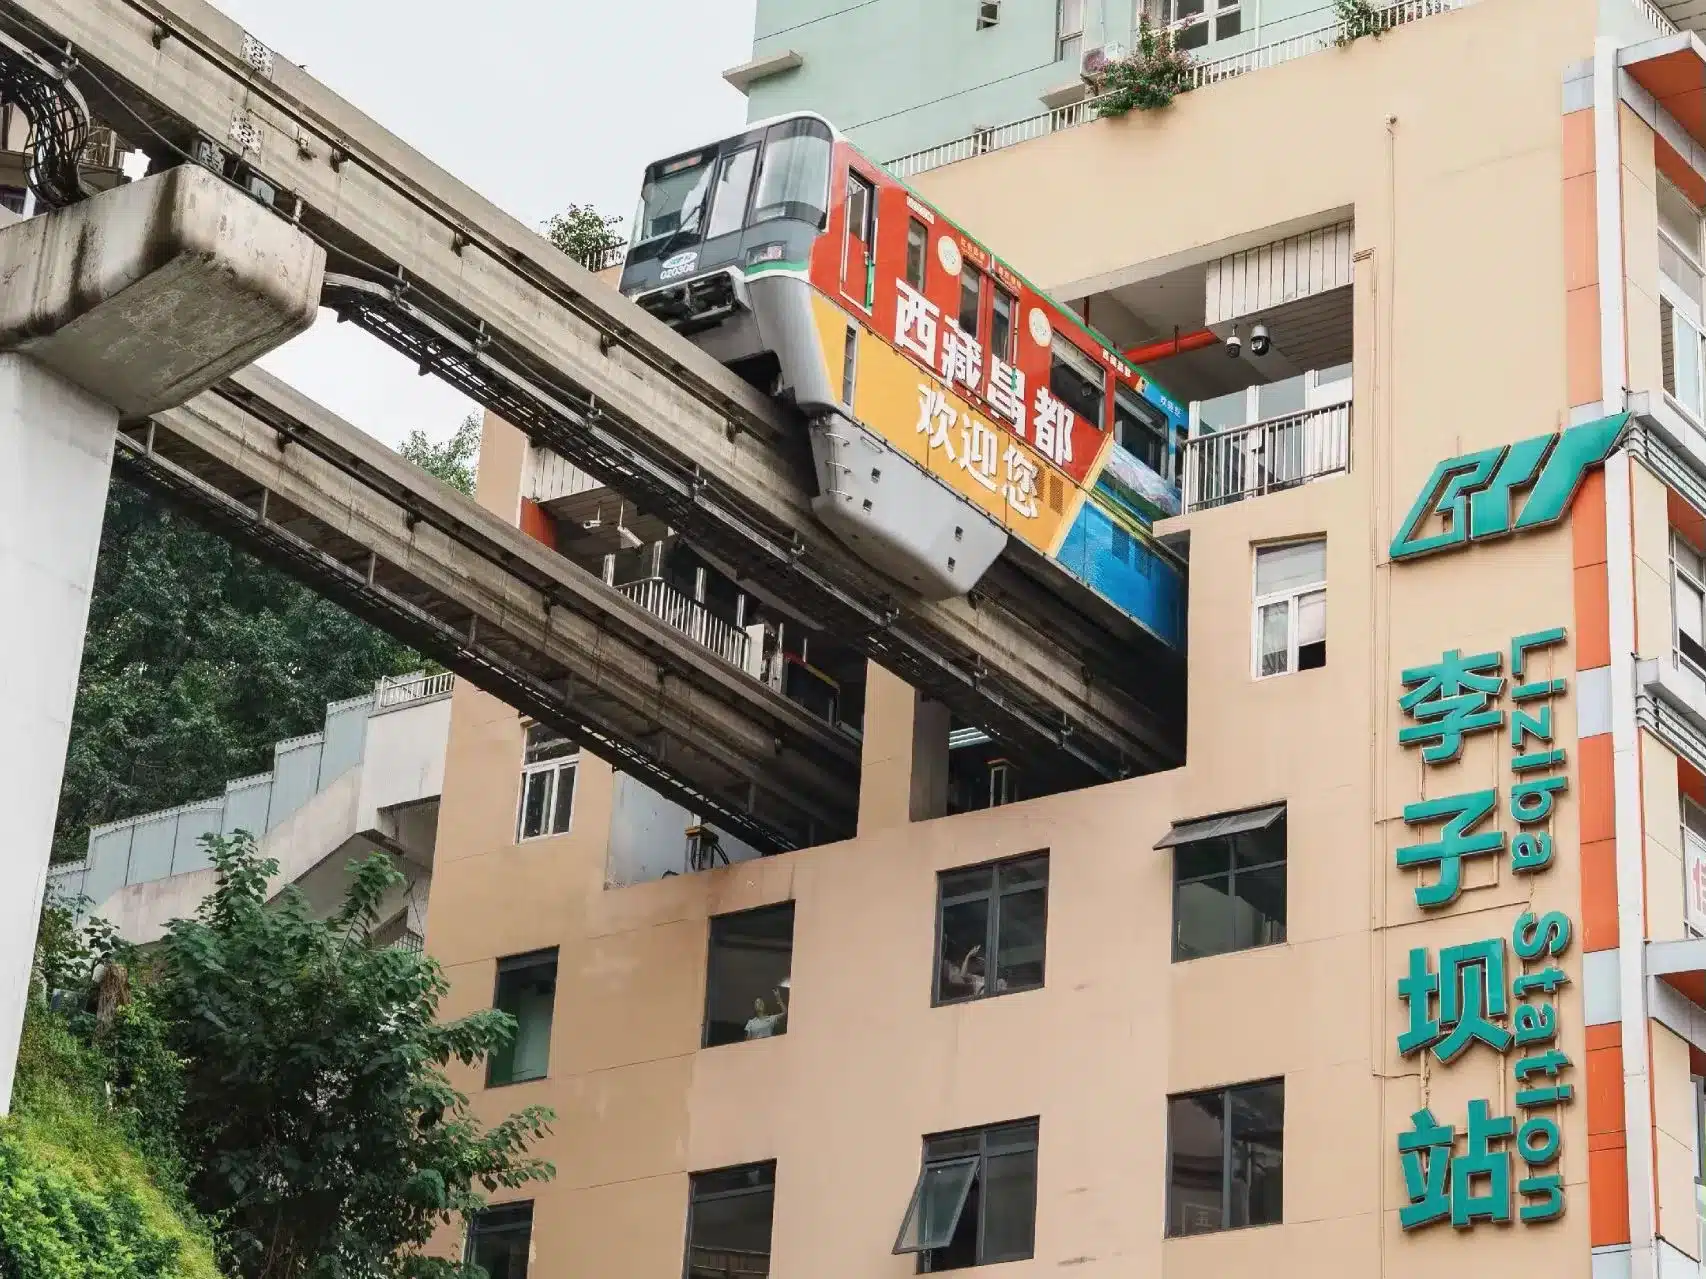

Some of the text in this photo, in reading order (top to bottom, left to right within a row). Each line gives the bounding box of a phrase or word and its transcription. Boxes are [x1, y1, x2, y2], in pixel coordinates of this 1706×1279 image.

[894, 278, 1075, 467] 西藏昌都
[916, 383, 1039, 519] 欢迎您
[1396, 648, 1516, 1232] 李子坝站
[1511, 626, 1575, 1224] Liziba Station
